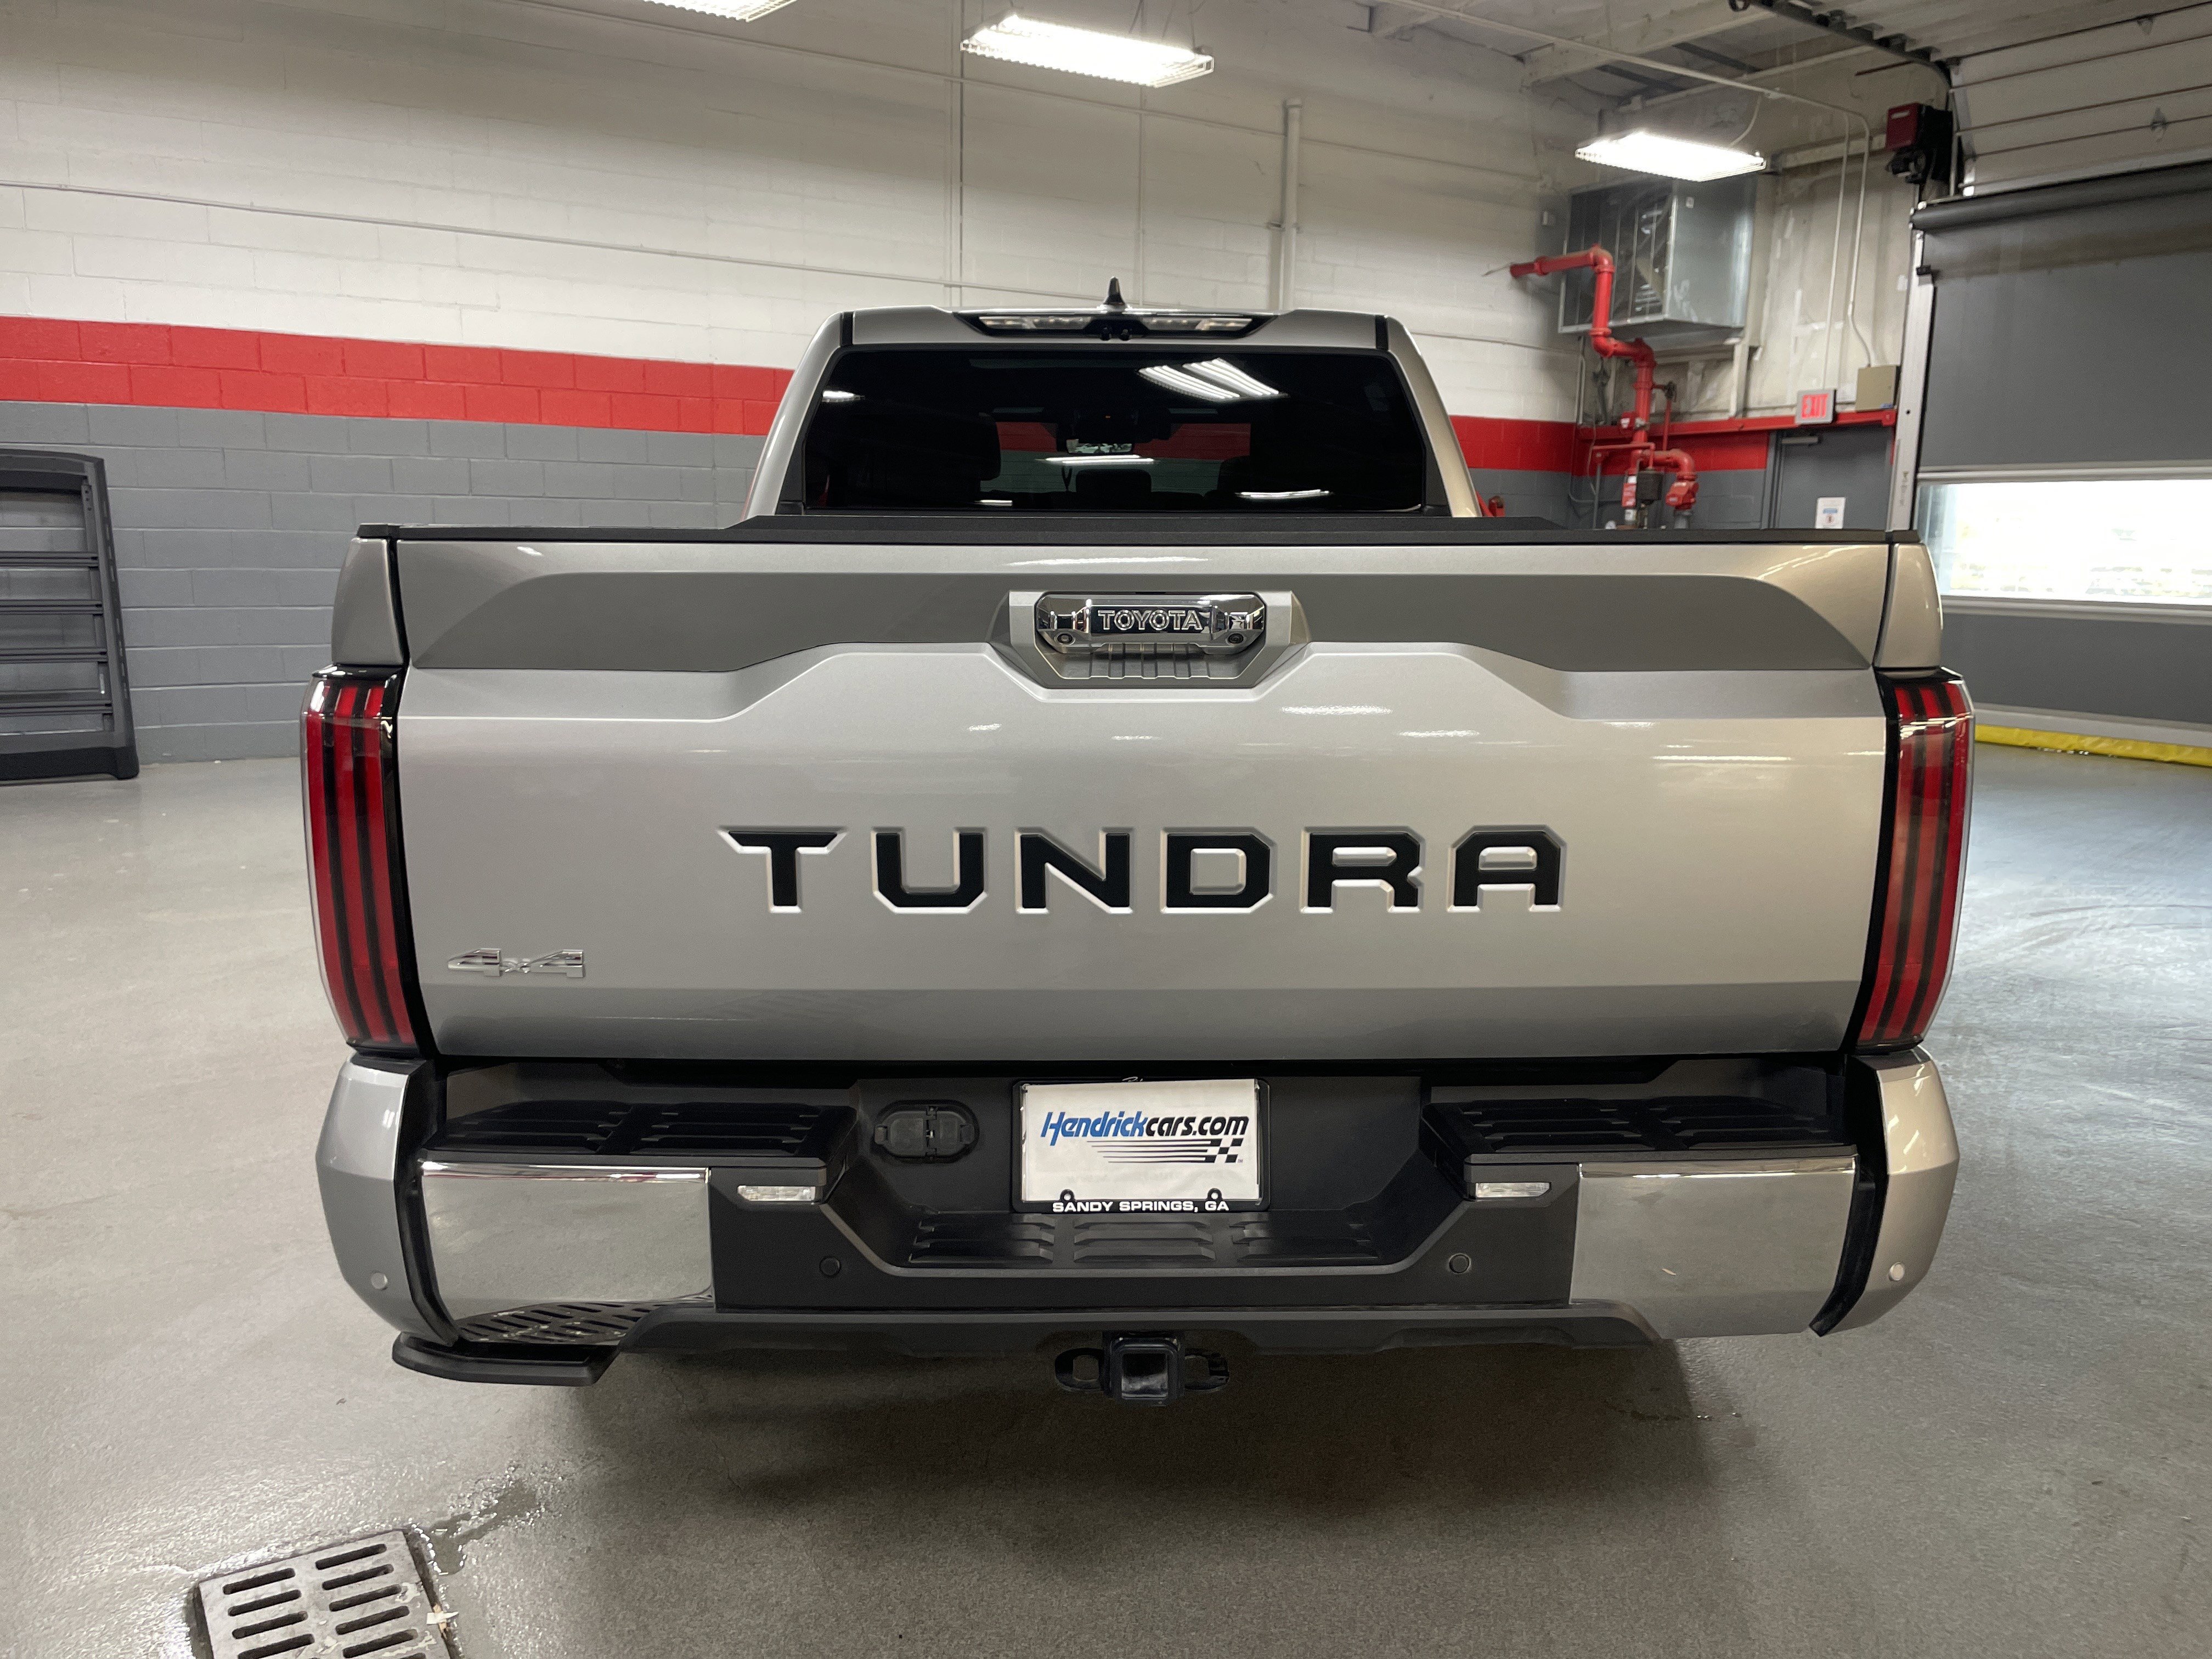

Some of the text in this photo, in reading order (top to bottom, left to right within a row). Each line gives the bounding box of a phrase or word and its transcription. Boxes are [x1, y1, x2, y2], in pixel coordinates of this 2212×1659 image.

[1802, 394, 1829, 418] EXIT
[1097, 609, 1203, 630] TOYOTA
[719, 825, 1568, 915] TUNDRA
[1040, 1111, 1250, 1146] Hendrickcars.com
[1052, 1200, 1229, 1213] SANDY SPRINGS, GA
